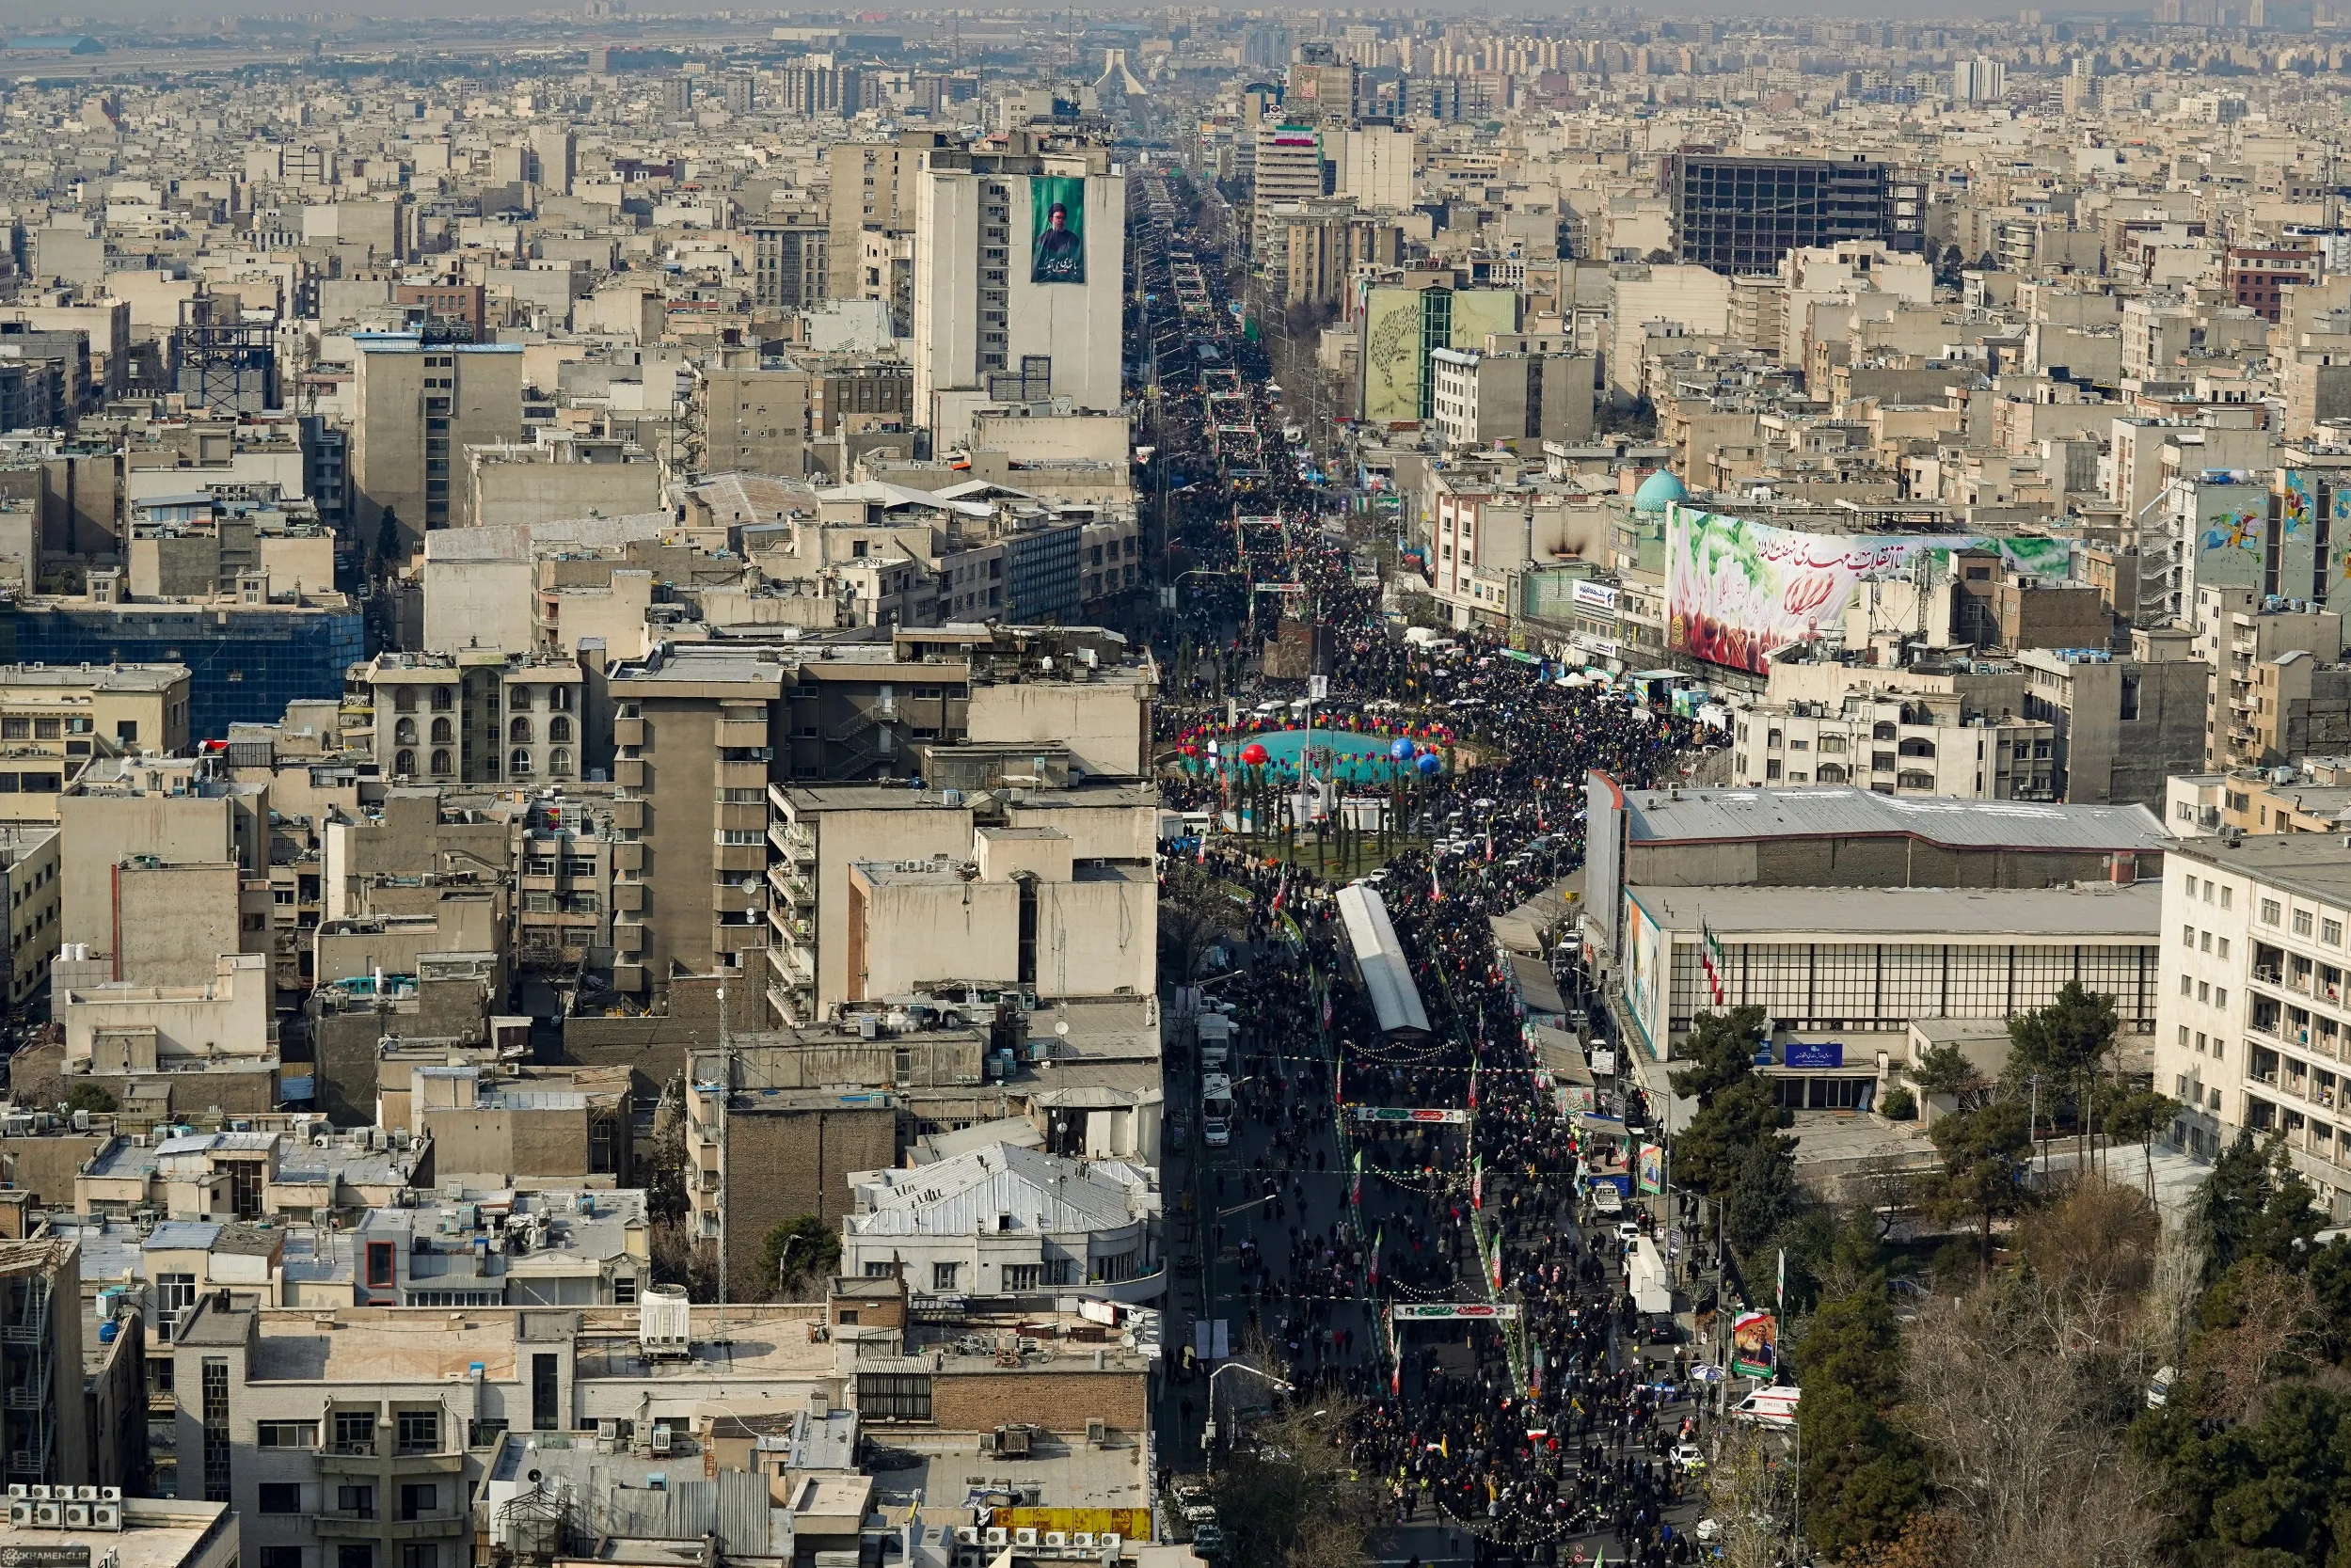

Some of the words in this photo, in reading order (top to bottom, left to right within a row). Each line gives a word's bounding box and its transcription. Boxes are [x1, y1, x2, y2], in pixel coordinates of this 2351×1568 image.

[1767, 539, 1797, 562] نهضت
[1794, 543, 1851, 569] مهدی
[1847, 546, 1896, 578] انقلاب
[1895, 546, 1905, 569] تا
